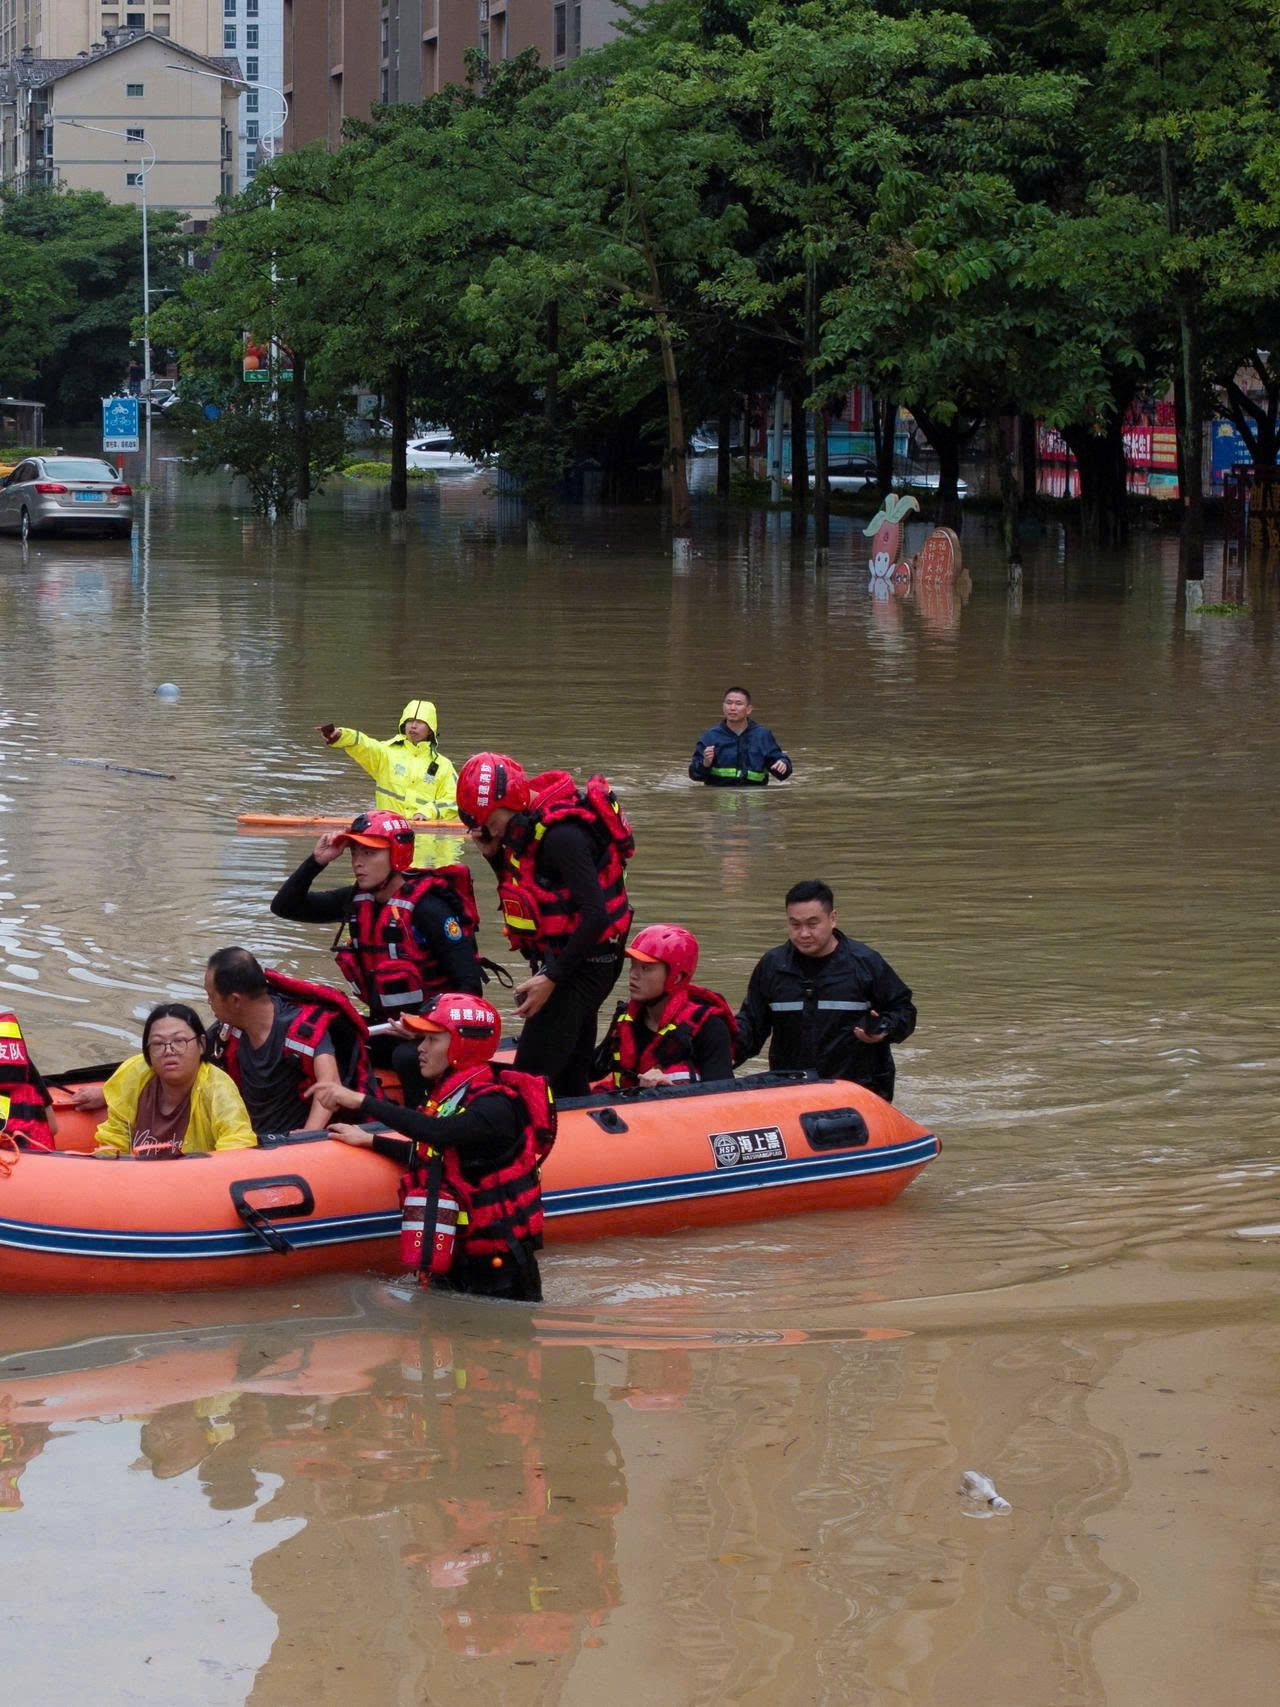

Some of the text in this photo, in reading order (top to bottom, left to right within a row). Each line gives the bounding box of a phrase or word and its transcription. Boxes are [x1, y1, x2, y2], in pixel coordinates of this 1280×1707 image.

[477, 762, 492, 807] 福建消防
[382, 819, 410, 832] 福建消
[449, 1008, 495, 1024] 福建消防
[718, 1145, 736, 1154] HSP
